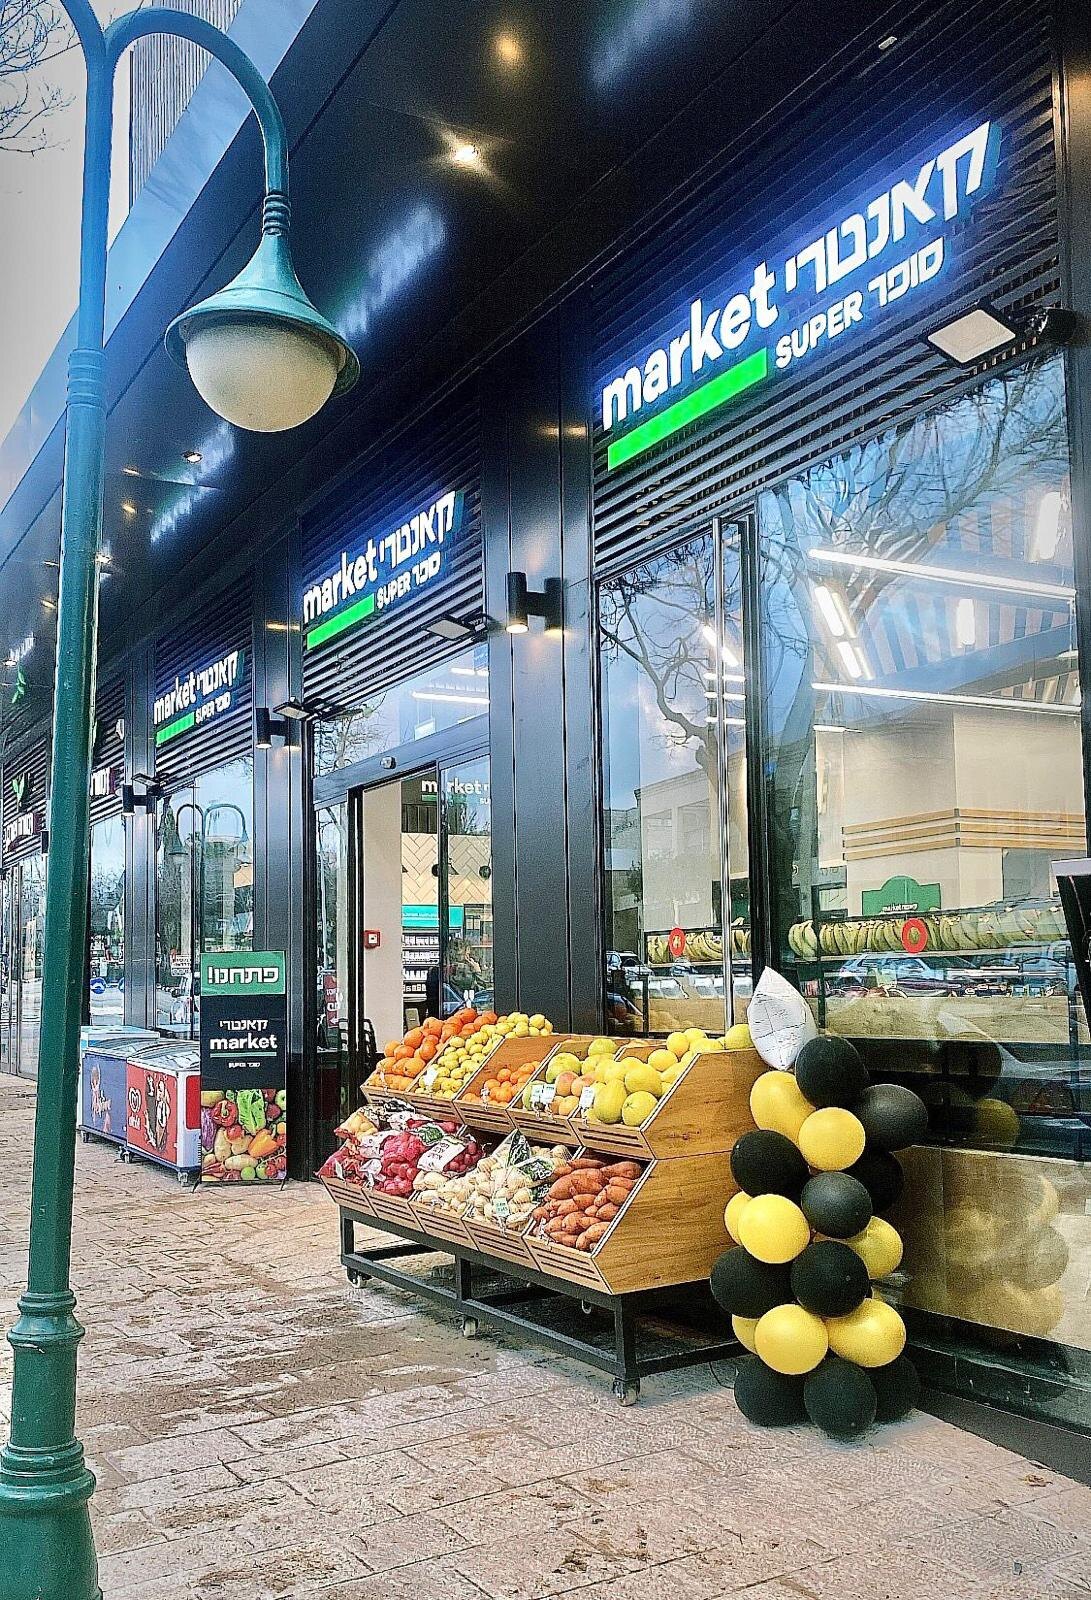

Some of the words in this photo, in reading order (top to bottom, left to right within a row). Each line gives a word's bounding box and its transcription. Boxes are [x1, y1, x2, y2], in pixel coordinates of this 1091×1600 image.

[785, 121, 990, 293] קאנטרי
[868, 236, 944, 307] סופר
[602, 262, 778, 431] market
[775, 290, 863, 369] SUPER
[379, 490, 455, 568] קאנטרי
[303, 539, 378, 623] market
[376, 571, 411, 609] SUPER
[153, 671, 196, 725] market
[421, 777, 481, 795] mrket
[208, 966, 279, 984] פתחנו!
[209, 1032, 278, 1050] market
[219, 1019, 268, 1032] קאנטרי
